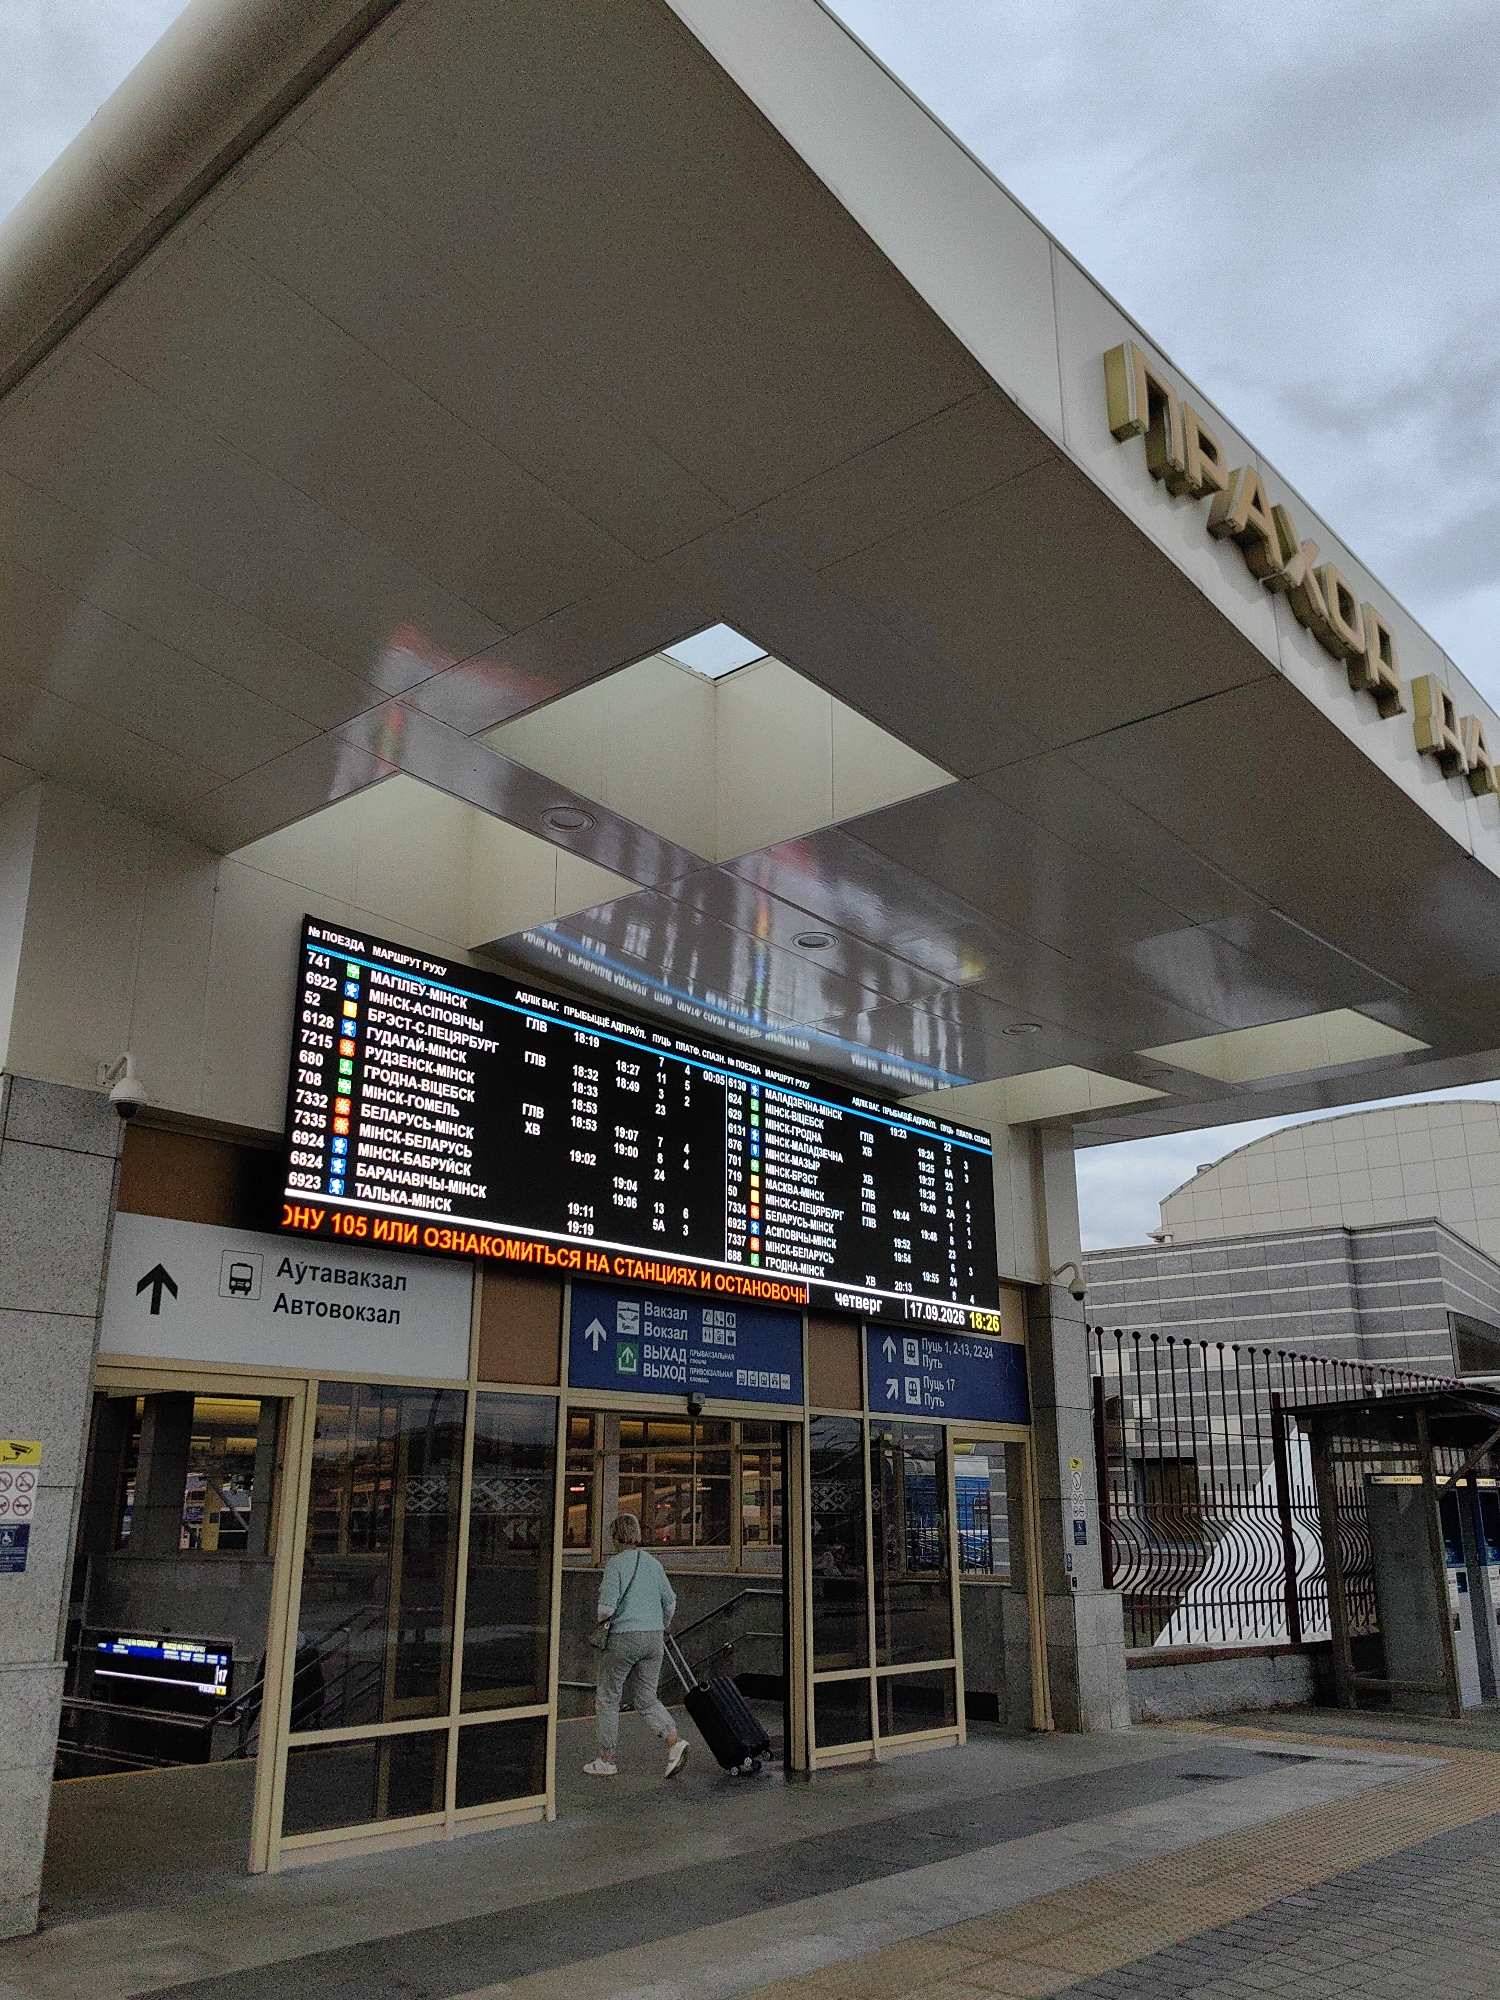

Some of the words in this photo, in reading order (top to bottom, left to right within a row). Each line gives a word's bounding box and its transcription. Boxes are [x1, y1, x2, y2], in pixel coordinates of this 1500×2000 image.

[1103, 338, 1407, 719] ПРАХОД
[307, 925, 321, 938] №
[321, 929, 366, 953] ПОЕЗДА
[372, 945, 422, 969] МАРШРУТ
[422, 961, 448, 977] РУХУ
[515, 990, 542, 1007] АДЛІК
[541, 998, 560, 1012] ВАГ.
[563, 1005, 611, 1028] ПРЫБЫЦЦЁ
[610, 1020, 647, 1040] АДПРАЎЛ.
[651, 1033, 672, 1048] ПУЦЬ
[675, 1040, 701, 1057] ПЛАТФ.
[701, 1049, 727, 1064] СПАЗН.
[308, 951, 330, 970] 741
[370, 969, 468, 1010] МАГІЛЕЎ-МІНСК
[525, 1016, 548, 1033] ГЛВ
[573, 1031, 600, 1048] 18:19
[658, 1056, 665, 1068] 7
[684, 1064, 691, 1076] 4
[703, 1069, 726, 1086] 00:05
[304, 990, 321, 1007] 52
[367, 1007, 500, 1054] БРЭСТ-С.ПЕЦЯРБУРГ
[524, 1050, 547, 1068] ГЛВ
[572, 1064, 599, 1082] 18:32
[615, 1076, 640, 1093] 18:49
[658, 1088, 665, 1100] 3
[684, 1095, 691, 1108] 2
[305, 970, 338, 992] 6922
[368, 988, 484, 1033] МІНСК-АСІПОВІЧЫ
[615, 1059, 641, 1077] 18:27
[656, 1071, 667, 1085] 11
[684, 1079, 691, 1092] 5
[301, 1028, 334, 1049] 7215
[364, 1045, 476, 1085] РУДЗЕНСК-МІНСК
[571, 1097, 598, 1115] 18:53
[302, 1009, 335, 1030] 6128
[366, 1026, 468, 1064] ГУДАГАЙ-МІНСК
[571, 1080, 599, 1098] 18:33
[654, 1103, 666, 1116] 23
[735, 1059, 762, 1075] ПОЕЗДА
[297, 1068, 322, 1087] 708
[361, 1083, 460, 1118] МІНСК-ГОМЕЛЬ
[524, 1120, 541, 1136] ХВ
[613, 1141, 639, 1159] 19:00
[656, 1152, 664, 1165] 8
[683, 1158, 690, 1171] 4
[299, 1049, 324, 1067] 680
[363, 1064, 476, 1103] ГРОДНА-ВІЦЕБСК
[522, 1102, 545, 1120] ГЛВ
[570, 1115, 598, 1132] 18:53
[614, 1125, 639, 1142] 19:07
[657, 1136, 664, 1148] 7
[683, 1143, 690, 1155] 4
[727, 1077, 747, 1092] 6130
[765, 1088, 843, 1121] МАЛАДЗЕЧНА-МІНСК
[943, 1142, 952, 1153] 22
[727, 1092, 743, 1106] 624
[764, 1102, 825, 1130] МІНСК-ВІЦЕБСК
[859, 1130, 875, 1144] ГЛВ
[294, 1109, 327, 1129] 7335
[358, 1122, 473, 1159] МІНСК-БЕЛАРУСЬ
[612, 1175, 638, 1193] 19:04
[295, 1088, 329, 1109] 7332
[360, 1102, 475, 1140] БЕЛАРУСЬ-МІНСК
[569, 1149, 597, 1167] 19:02
[653, 1168, 666, 1182] 24
[727, 1107, 743, 1121] 629
[764, 1117, 823, 1144] МІНСК-ГРОДНА
[861, 1145, 873, 1158] ХВ
[727, 1122, 746, 1137] 6131
[765, 1132, 844, 1164] МІНСК-МАЛАДЗЕЧНА
[945, 1181, 954, 1192] 23
[291, 1129, 326, 1149] 6924
[357, 1142, 472, 1177] МІНСК-БАБРУЙСК
[612, 1192, 638, 1209] 19:06
[653, 1201, 665, 1215] 13
[682, 1207, 689, 1220] 6
[727, 1137, 743, 1152] 876
[765, 1147, 821, 1172] МІНСК-МАЗЫР
[862, 1173, 874, 1186] ХВ
[727, 1153, 742, 1167] 701
[765, 1162, 819, 1186] МІНСК-БРЭСТ
[861, 1186, 876, 1201] ГЛВ
[288, 1171, 322, 1190] 6923
[354, 1182, 453, 1213] ТАЛЬКА-МІНСК
[566, 1220, 595, 1237] 19:19
[290, 1150, 324, 1170] 6824
[355, 1162, 487, 1199] БАРАНАВІЧЫ-МІНСК
[567, 1202, 594, 1219] 19:11
[652, 1218, 666, 1232] 5А
[682, 1224, 689, 1237] 3
[727, 1168, 743, 1183] 719
[765, 1177, 825, 1202] МАСКВА-МІНСК
[861, 1201, 877, 1215] ГЛВ
[727, 1184, 738, 1198] 50
[765, 1193, 845, 1221] МІНСК-С.ПЕЦЯРБУРГ
[861, 1215, 877, 1229] ГЛВ
[727, 1200, 747, 1216] 7334
[765, 1208, 835, 1235] БЕЛАРУСЬ-МІНСК
[948, 1249, 957, 1260] 23
[727, 1216, 747, 1231] 6925
[764, 1224, 837, 1250] АСІПОВІЧЫ-МІНСК
[276, 1256, 407, 1292] Аўтавакзал
[331, 1212, 367, 1237] 105
[373, 1218, 419, 1245] ИЛИ
[423, 1227, 582, 1269] ОЗНАКОМИТЬСЯ
[585, 1251, 610, 1274] НА
[613, 1257, 698, 1288] СТАНЦИЯХ
[700, 1270, 711, 1290] И
[714, 1273, 807, 1305] ОСТАНОВОЧН
[727, 1232, 747, 1247] 7337
[765, 1239, 835, 1264] МІНСК-БЕЛАРУСЬ
[949, 1276, 958, 1288] 24
[727, 1248, 743, 1263] 688
[765, 1256, 825, 1278] ГРОДНА-МІНСК
[865, 1274, 877, 1287] ХВ
[273, 1292, 401, 1325] Автовокзал
[644, 1300, 688, 1321] Вакзал
[834, 1291, 883, 1316] четверг
[909, 1301, 966, 1326] 17.09.2026
[969, 1311, 1000, 1332] 18:26
[643, 1344, 687, 1365] ВЫХАД
[644, 1321, 688, 1341] Вокзал
[922, 1337, 943, 1354] Пуць
[973, 1345, 994, 1359] 22-24
[643, 1362, 687, 1384] ВЫХОД
[922, 1354, 943, 1371] Путь
[923, 1375, 945, 1392] Пуць
[946, 1378, 956, 1392] 17
[924, 1393, 945, 1410] Путь
